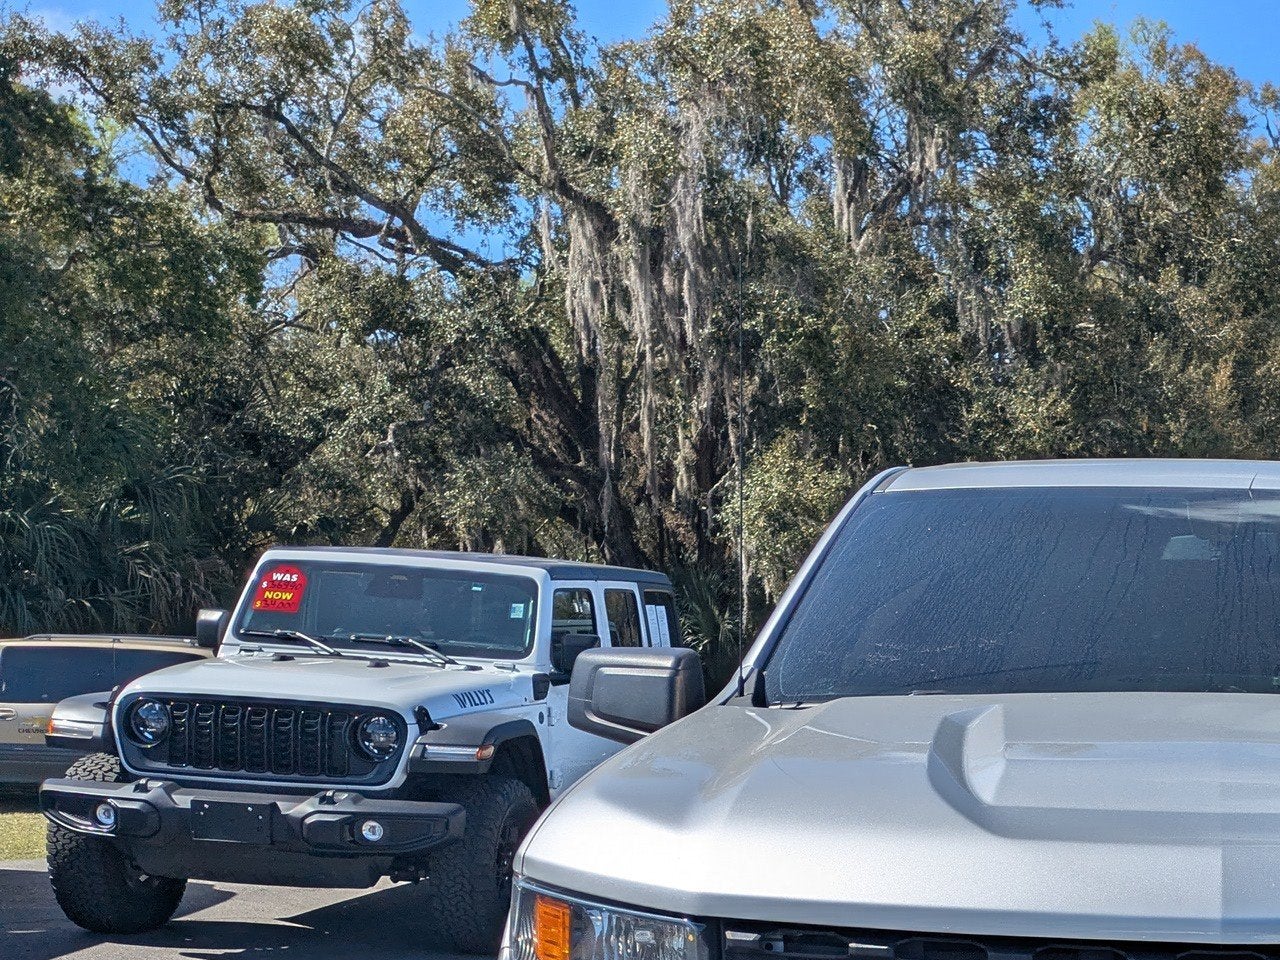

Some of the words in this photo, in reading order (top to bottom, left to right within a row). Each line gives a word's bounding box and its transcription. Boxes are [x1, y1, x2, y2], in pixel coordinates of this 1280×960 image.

[272, 573, 298, 581] WAS
[264, 591, 293, 600] NOW
[451, 688, 495, 709] WILLYS
